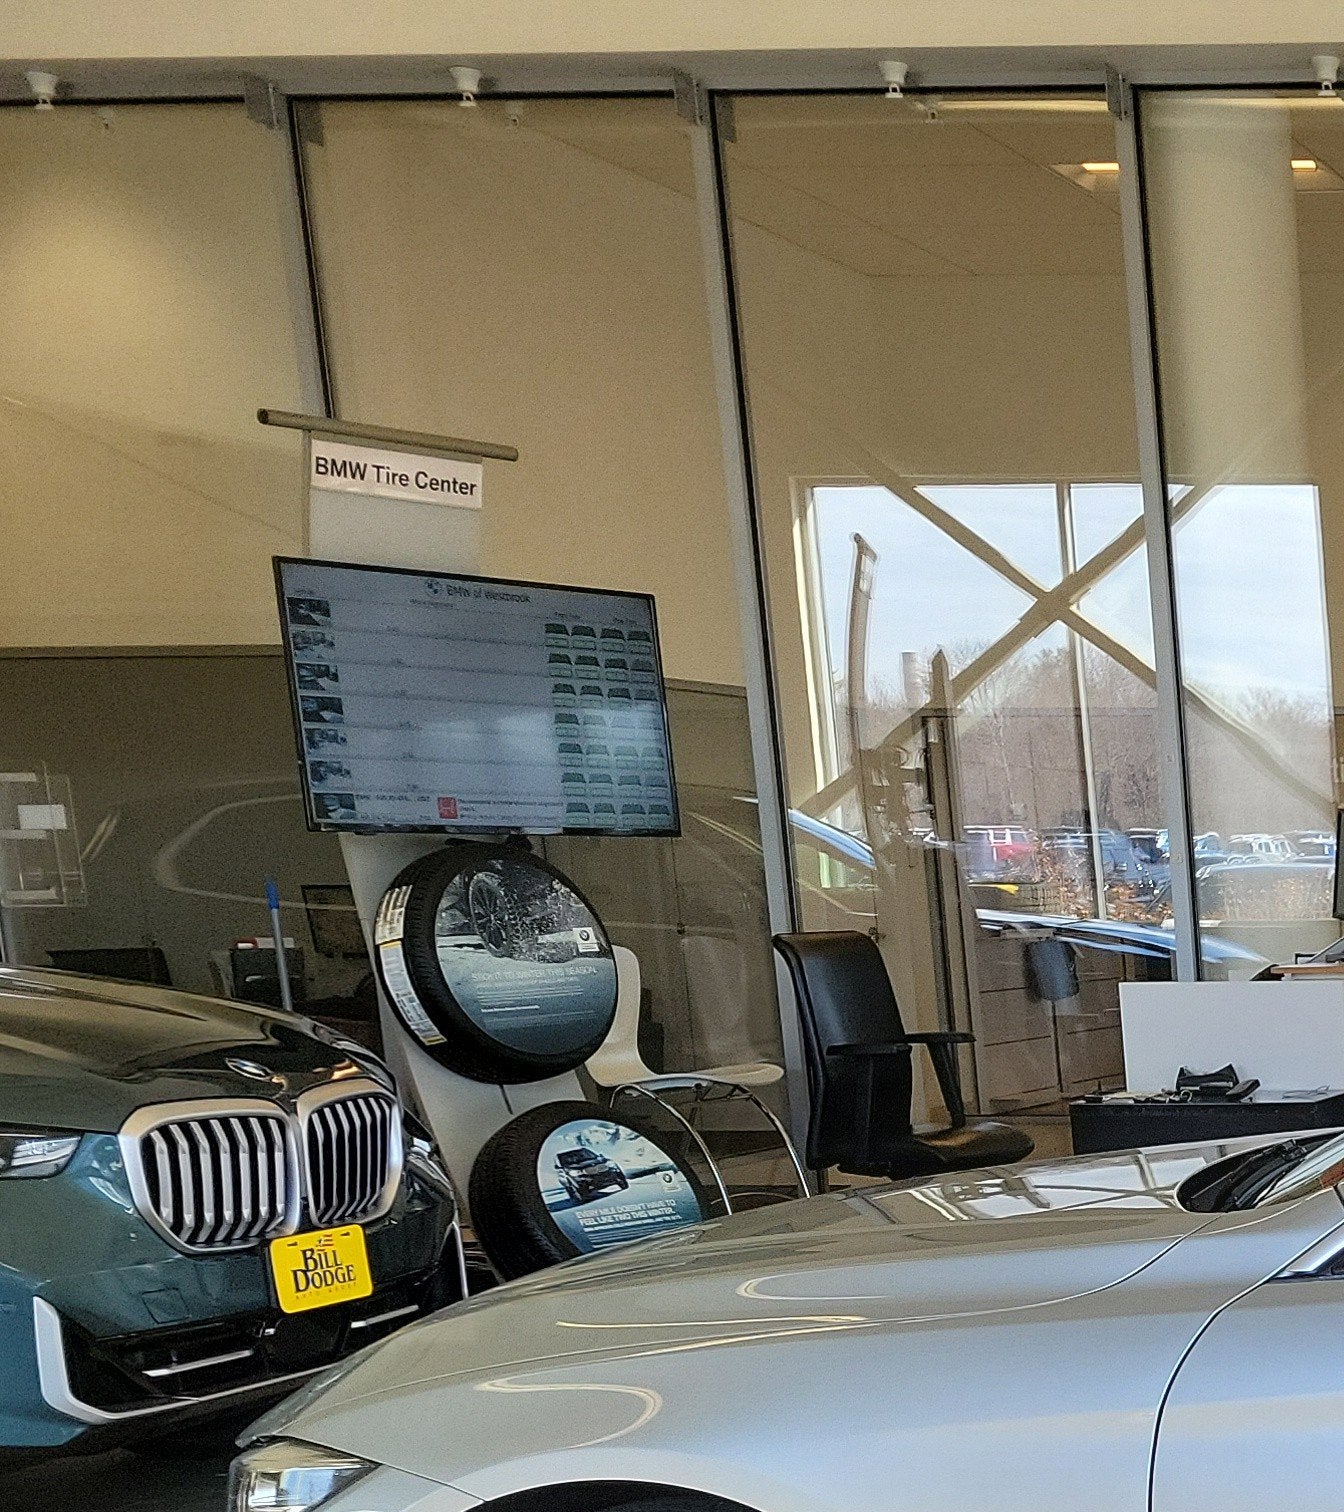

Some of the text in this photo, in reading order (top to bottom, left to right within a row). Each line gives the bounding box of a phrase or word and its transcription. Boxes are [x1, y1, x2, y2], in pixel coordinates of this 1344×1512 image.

[315, 456, 477, 496] BMW Tire Center
[300, 1248, 342, 1272] BILL
[290, 1264, 356, 1293] DODGE
